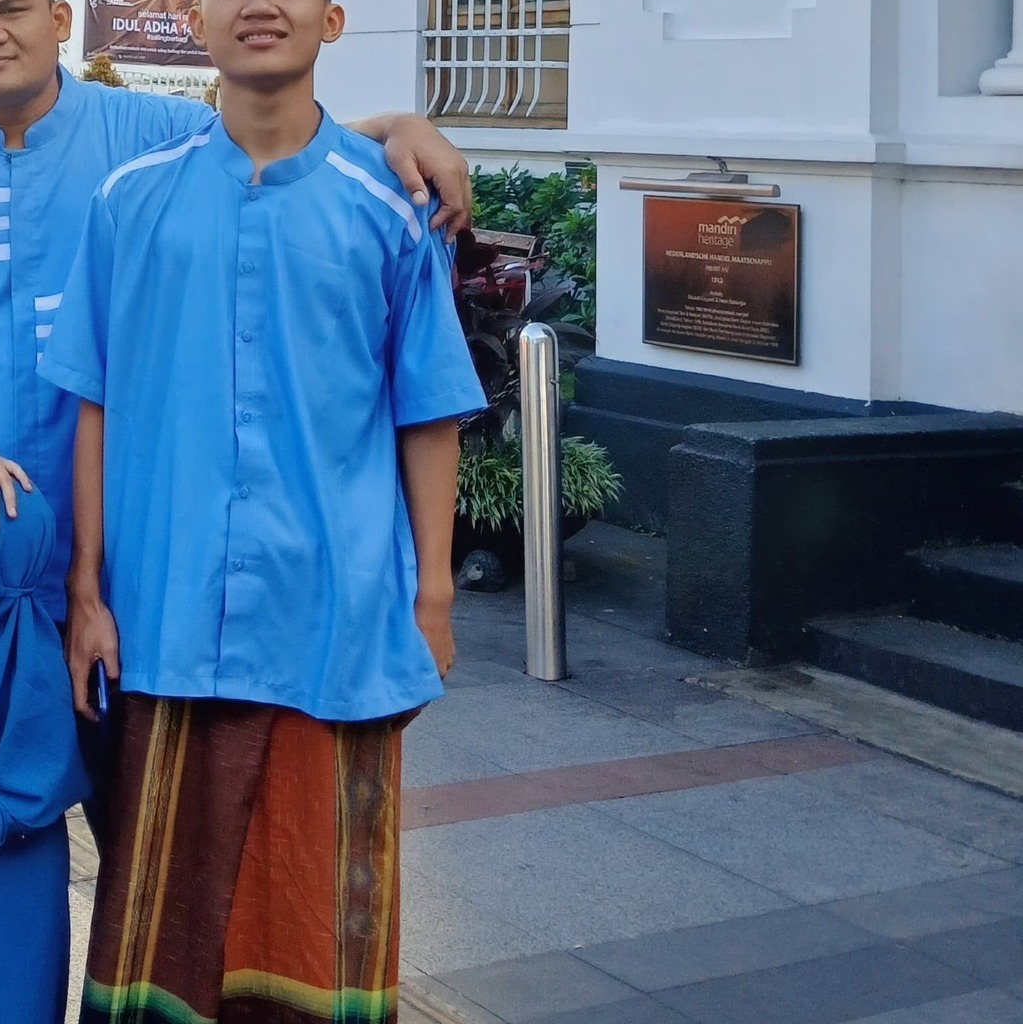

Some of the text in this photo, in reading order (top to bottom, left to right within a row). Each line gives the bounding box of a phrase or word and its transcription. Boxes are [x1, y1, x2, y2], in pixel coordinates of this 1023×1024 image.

[112, 17, 141, 32] IDUL
[143, 20, 178, 35] ADHA
[698, 221, 737, 235] mandiri
[698, 232, 735, 249] heritage
